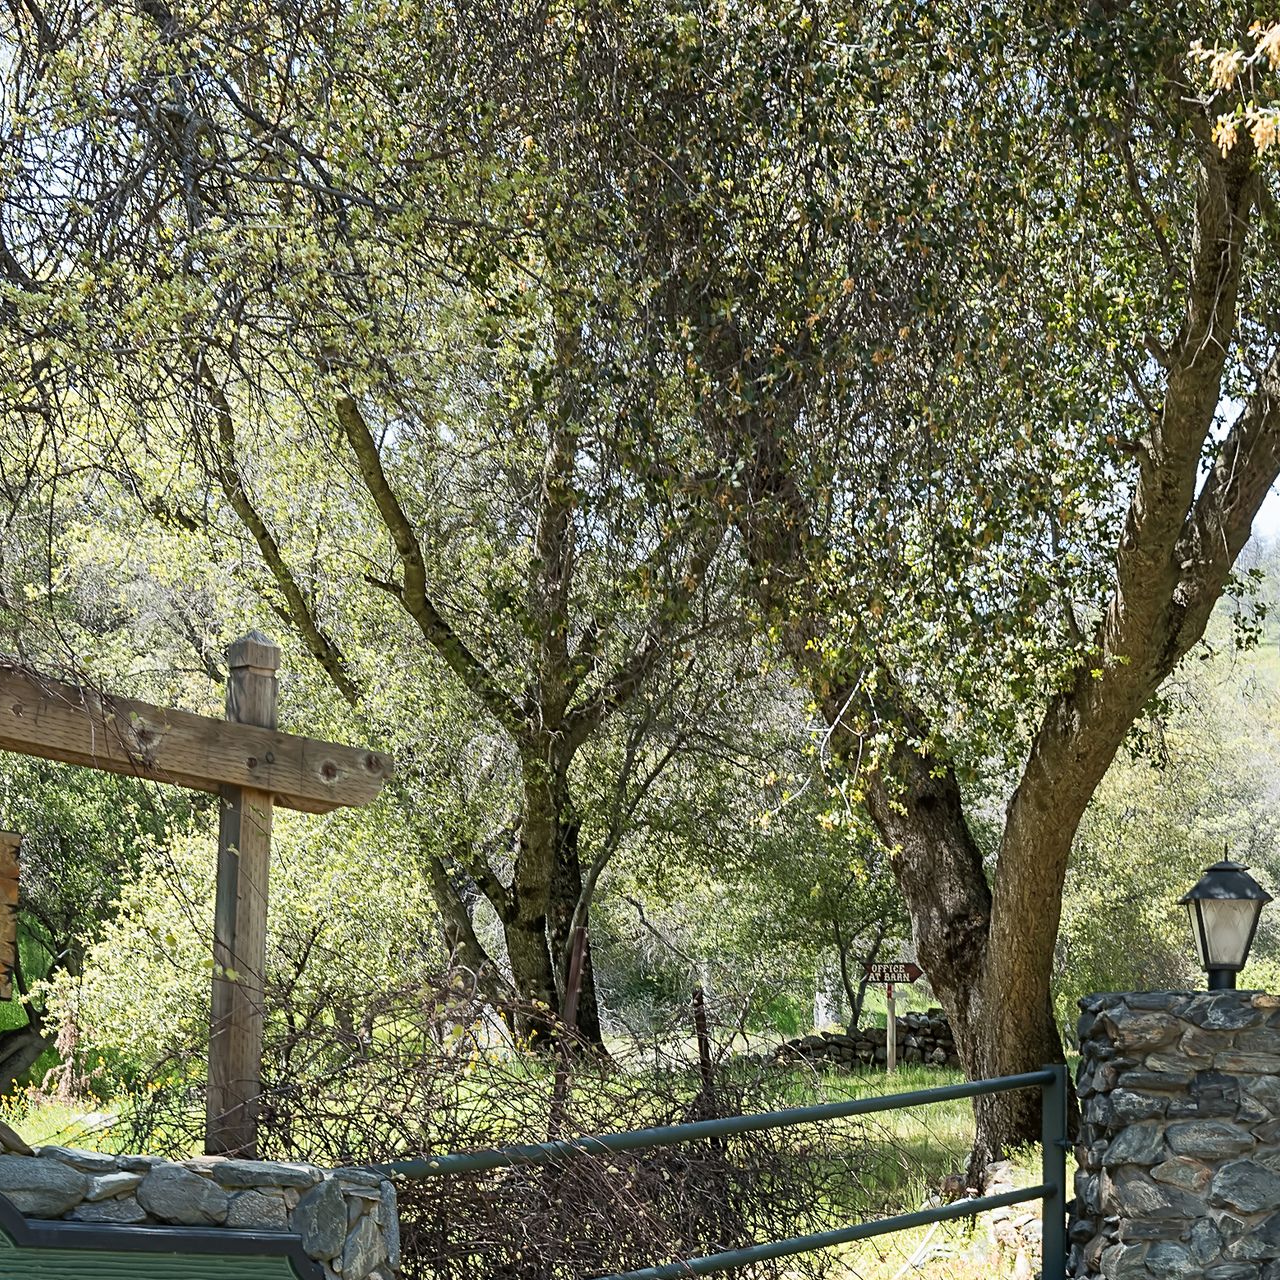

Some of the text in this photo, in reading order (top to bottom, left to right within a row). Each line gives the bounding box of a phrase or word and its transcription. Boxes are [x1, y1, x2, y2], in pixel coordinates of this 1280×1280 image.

[871, 964, 905, 973] OFFICE
[868, 973, 910, 982] AT BARN
